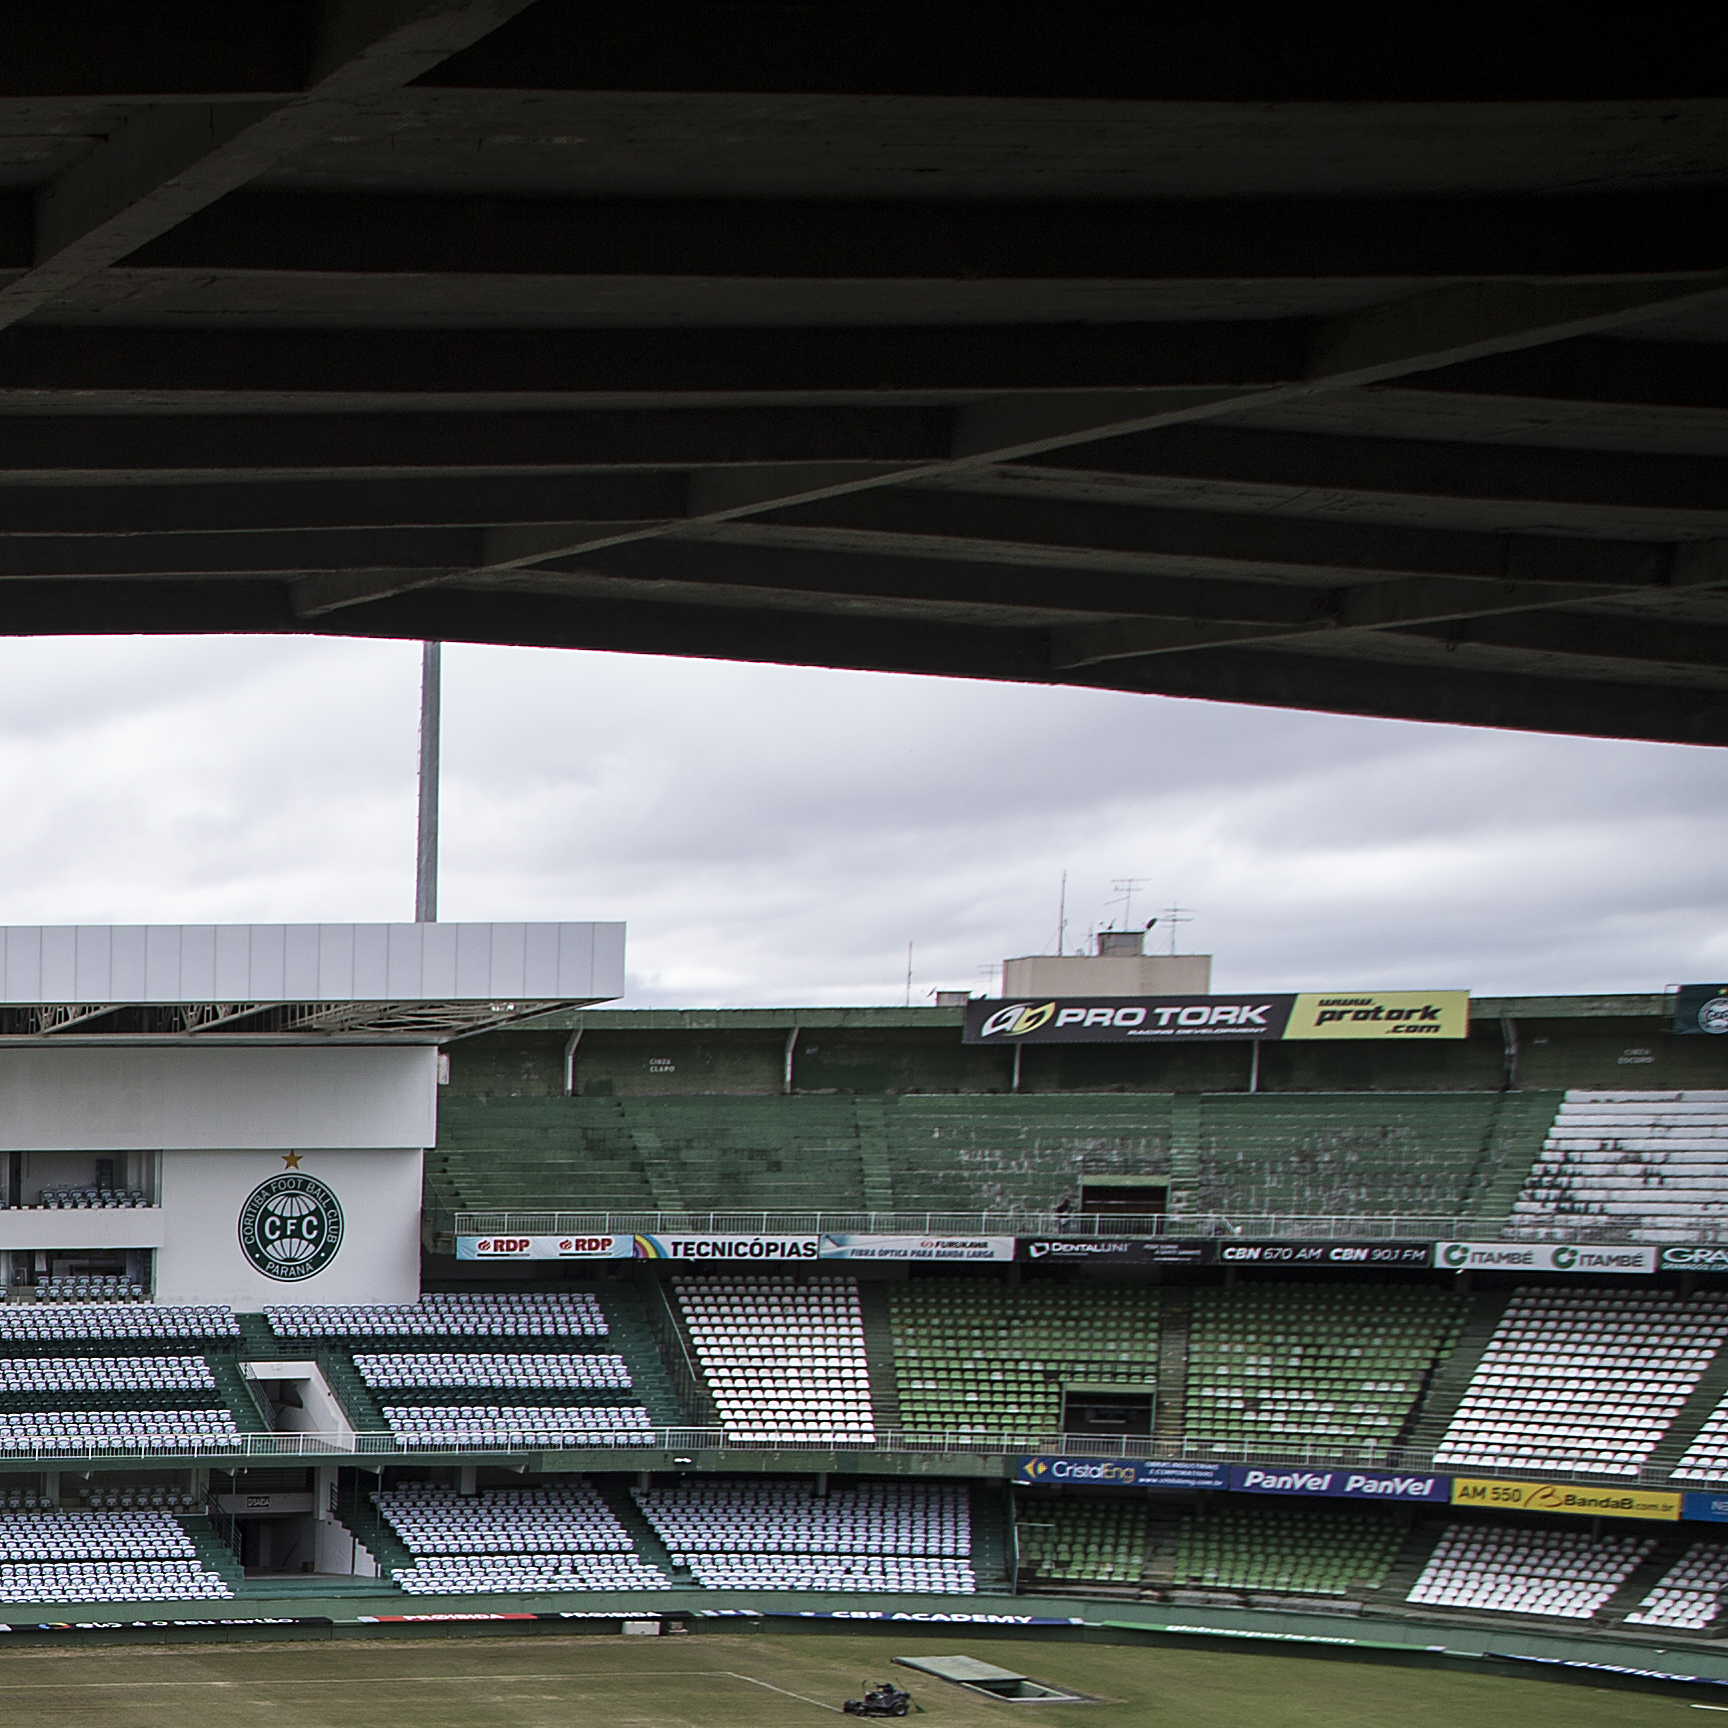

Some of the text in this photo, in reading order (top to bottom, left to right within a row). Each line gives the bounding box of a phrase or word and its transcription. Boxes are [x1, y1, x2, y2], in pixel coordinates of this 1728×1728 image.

[1054, 1002, 1273, 1028] PRO TORK
[1315, 1003, 1443, 1028] protork
[1385, 1022, 1442, 1035] .com
[244, 1178, 340, 1245] CORITIBA FOOT BALL CLUB
[264, 1215, 319, 1240] CFC
[492, 1239, 531, 1253] RDP
[574, 1238, 613, 1252] RDP
[671, 1238, 817, 1258] TECNICÓPIAS
[1222, 1247, 1261, 1261] CBN
[1262, 1247, 1294, 1260] 670
[1294, 1247, 1323, 1260] AM
[1329, 1247, 1367, 1261] CBN
[1401, 1249, 1427, 1261] FM
[1470, 1249, 1534, 1266] ITAMBÉ
[1579, 1251, 1645, 1268] ITAMBÉ
[1243, 1470, 1333, 1492] PanVel
[1344, 1474, 1435, 1496] PanVel
[1458, 1486, 1522, 1502] AM 550
[831, 1611, 1032, 1624] CBF ACADEMY
